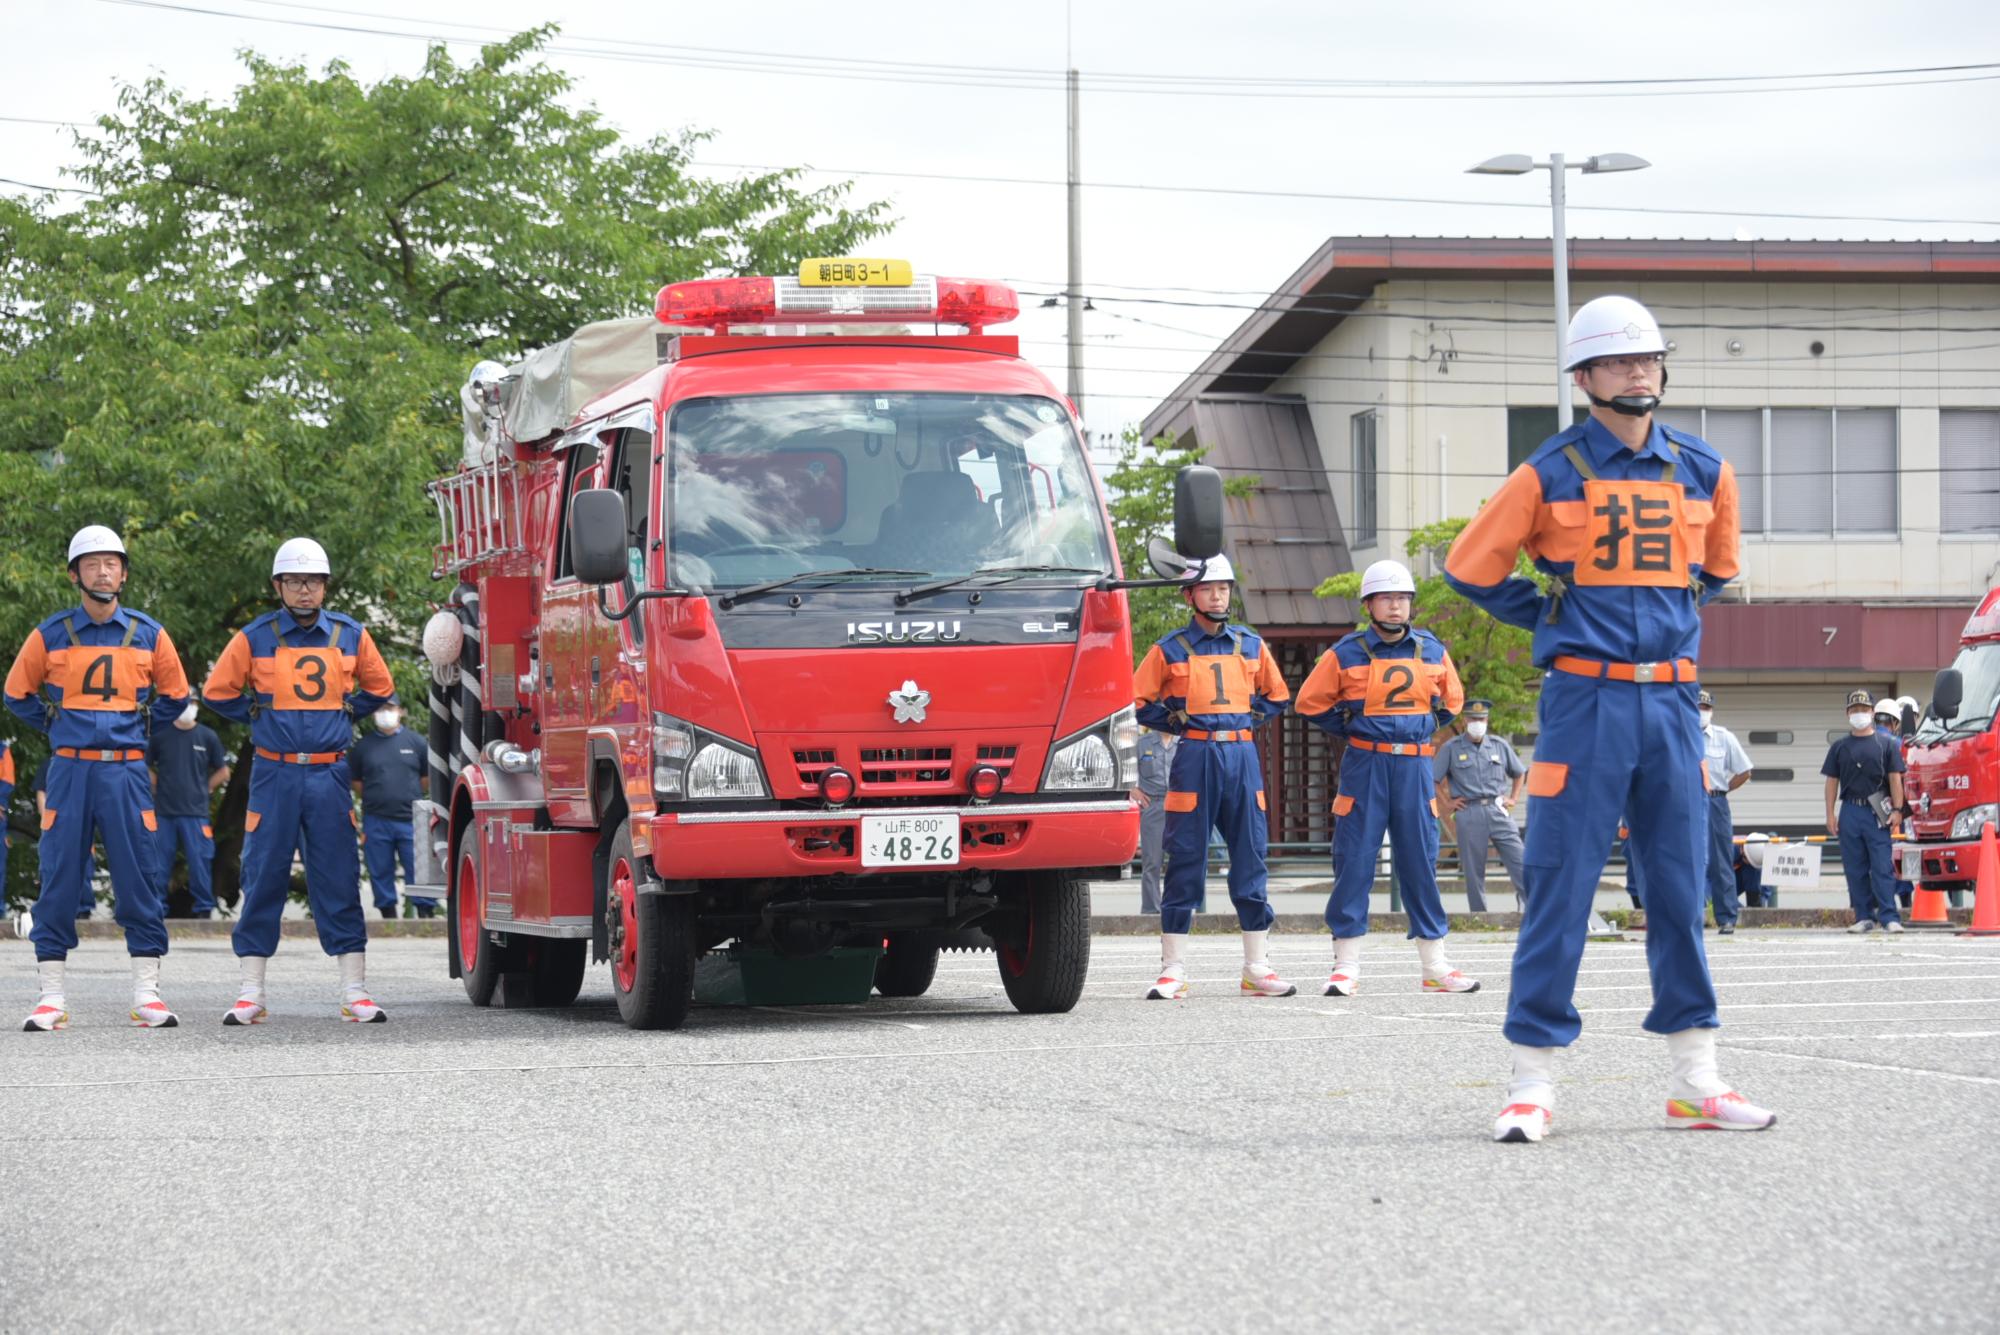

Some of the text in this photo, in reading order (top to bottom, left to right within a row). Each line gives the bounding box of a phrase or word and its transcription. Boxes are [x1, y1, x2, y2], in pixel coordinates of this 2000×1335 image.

[819, 263, 889, 282] 朝日町3-1
[1592, 494, 1673, 572] 指
[847, 620, 961, 643] ISUZU
[1022, 622, 1069, 633] ELF
[1822, 627, 1838, 645] 7
[81, 654, 119, 702] 4
[294, 654, 327, 702] 3
[1209, 662, 1231, 705] 1
[1381, 665, 1416, 708] 2
[885, 819, 938, 833] 山形 800
[883, 835, 954, 861] 48-26
